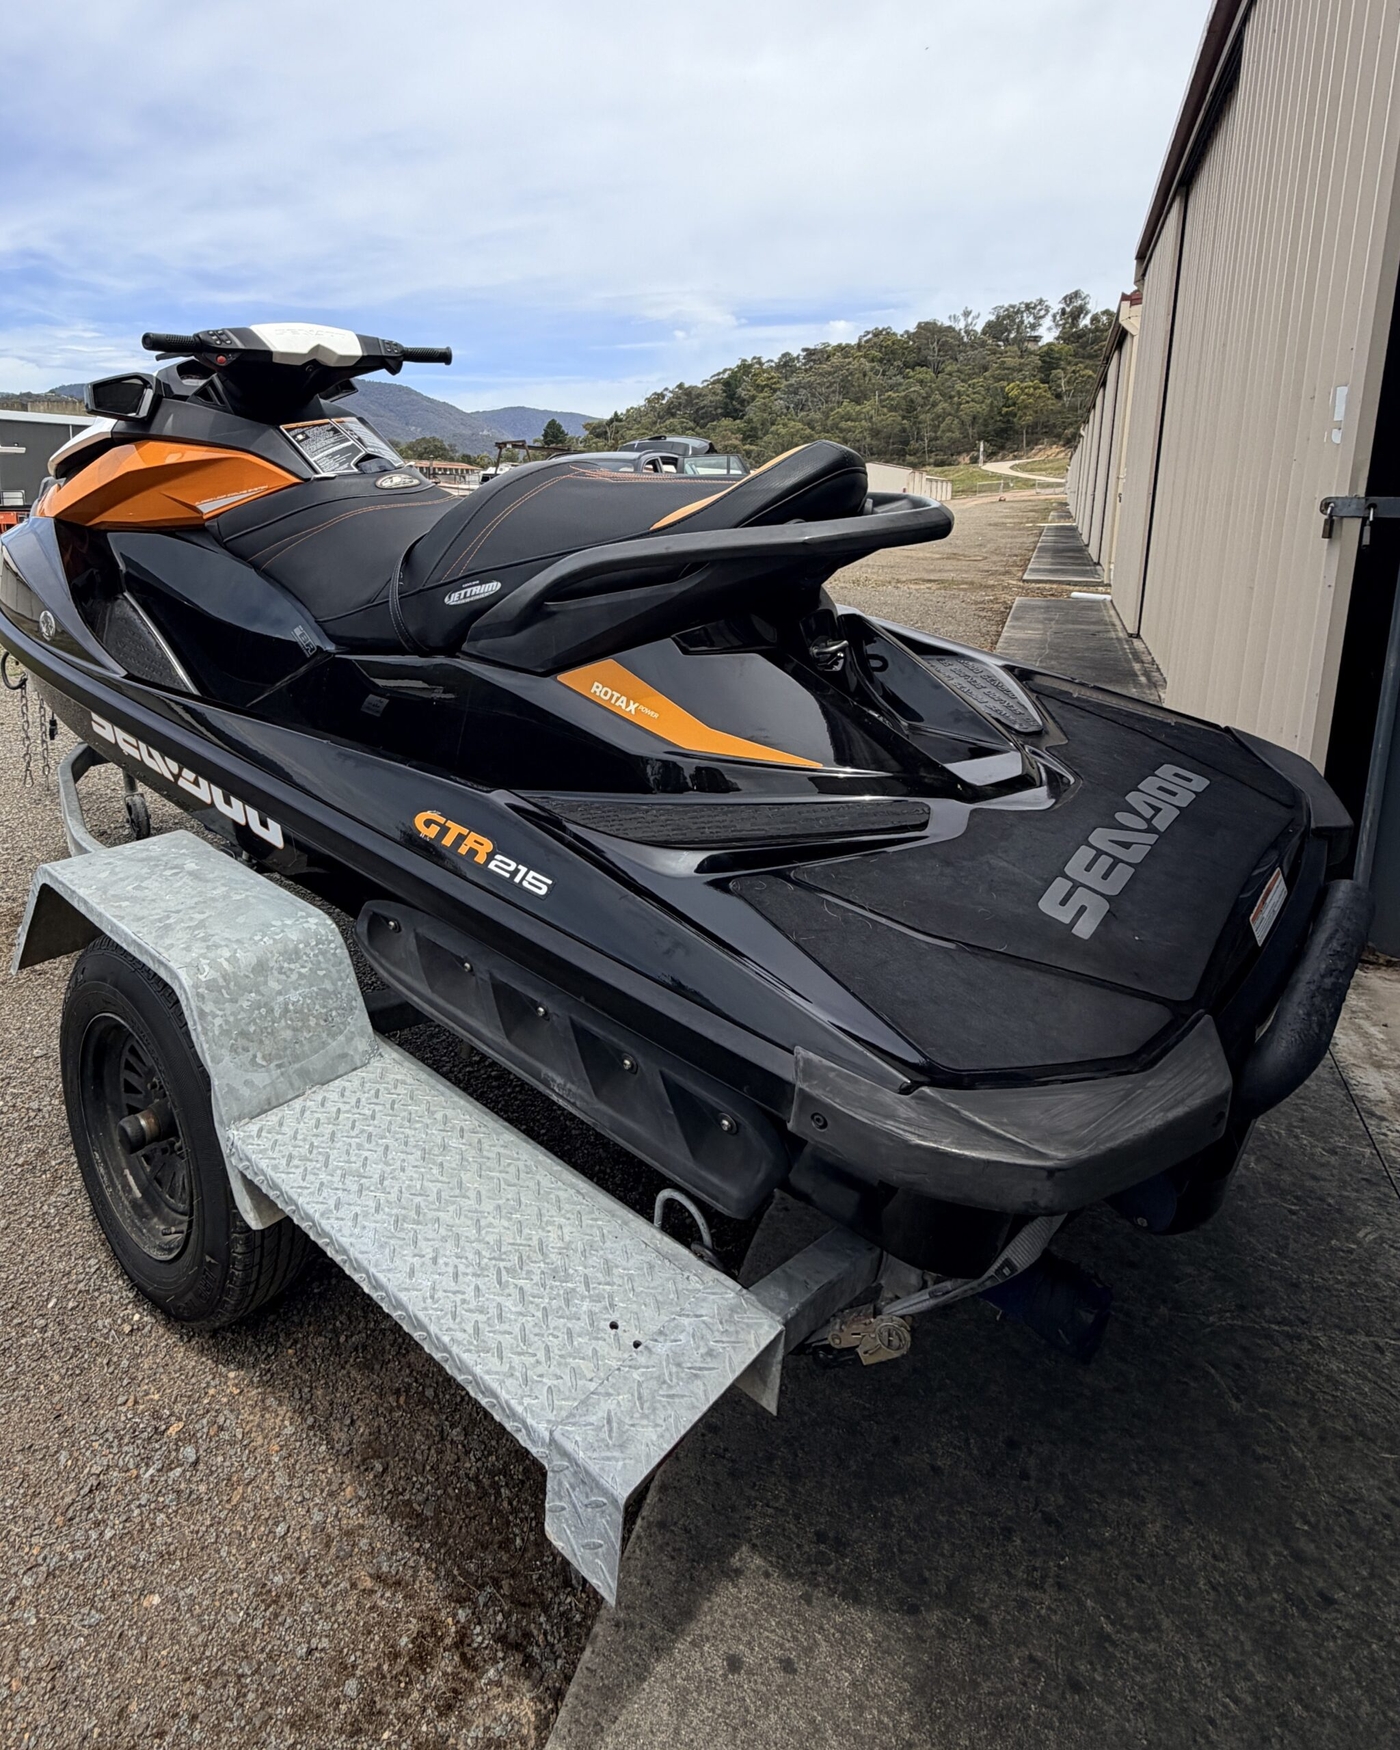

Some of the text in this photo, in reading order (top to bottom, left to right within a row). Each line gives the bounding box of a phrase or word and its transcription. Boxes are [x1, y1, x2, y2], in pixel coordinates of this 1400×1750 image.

[590, 681, 660, 719] ROTAX POWER
[414, 810, 494, 865] GTR
[487, 854, 553, 896] 215
